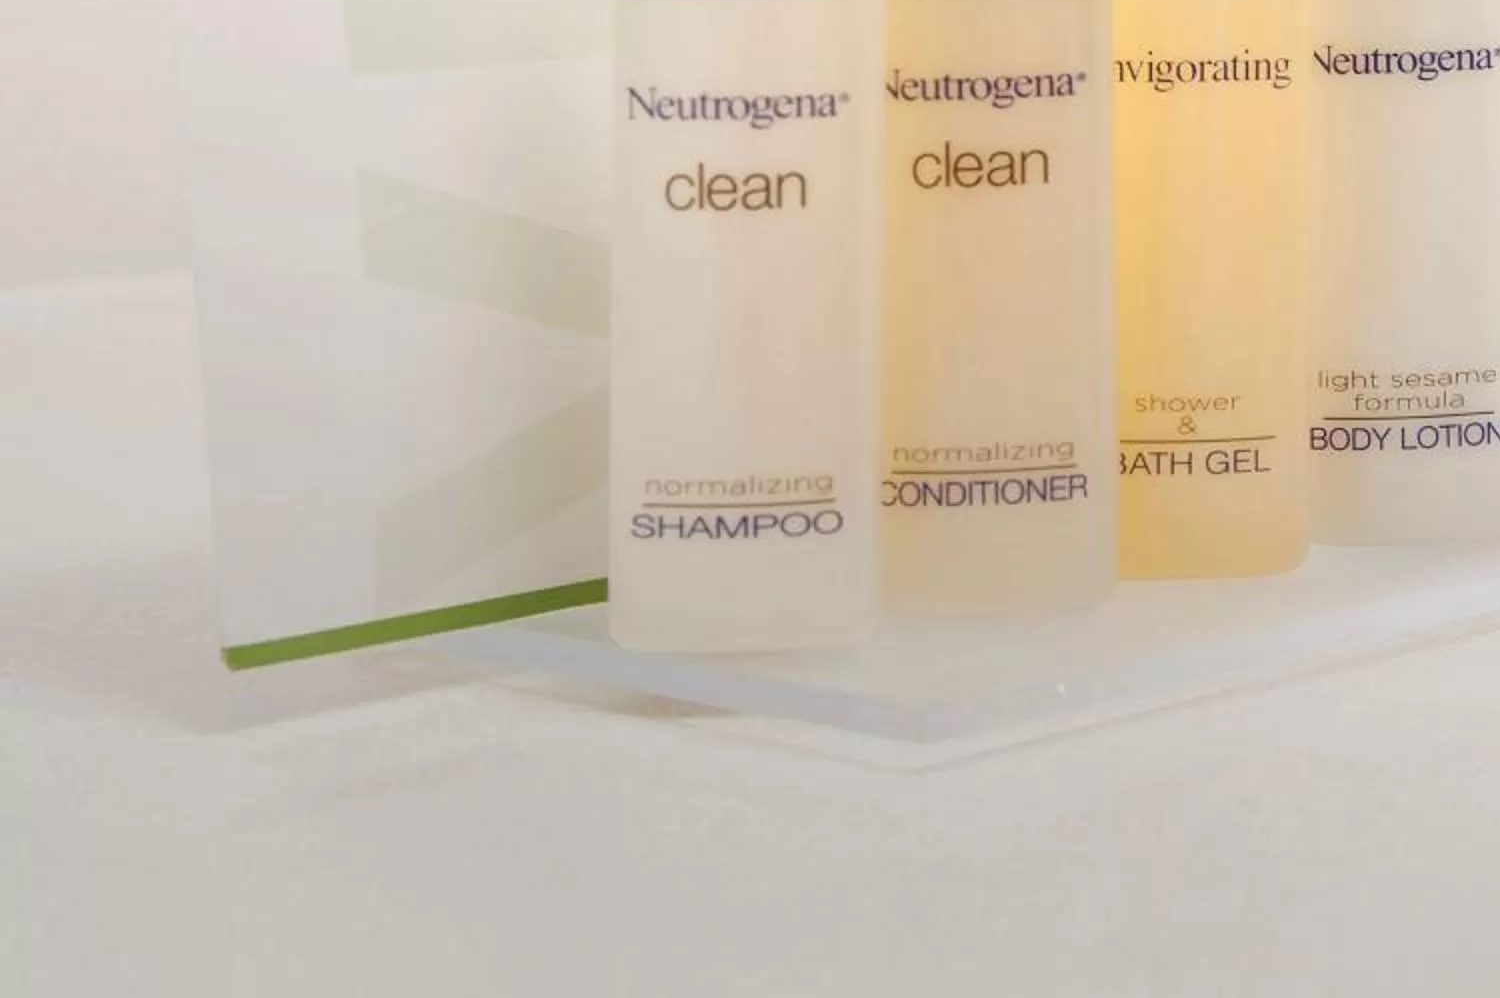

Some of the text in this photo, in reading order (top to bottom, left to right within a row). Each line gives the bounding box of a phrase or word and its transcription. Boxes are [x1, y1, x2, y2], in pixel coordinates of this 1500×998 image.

[1114, 48, 1293, 93] nvigorating
[912, 141, 1050, 190] clean
[664, 162, 808, 212] clean
[1317, 368, 1498, 393] light sesame
[1134, 393, 1242, 413] shower
[1352, 389, 1465, 412] formula
[1177, 415, 1199, 436] &
[892, 439, 1076, 463] normalizing
[1309, 426, 1392, 452] BODY
[1204, 448, 1273, 475] GEL
[643, 473, 834, 498] normalizing
[630, 509, 845, 539] SHAMPOO
